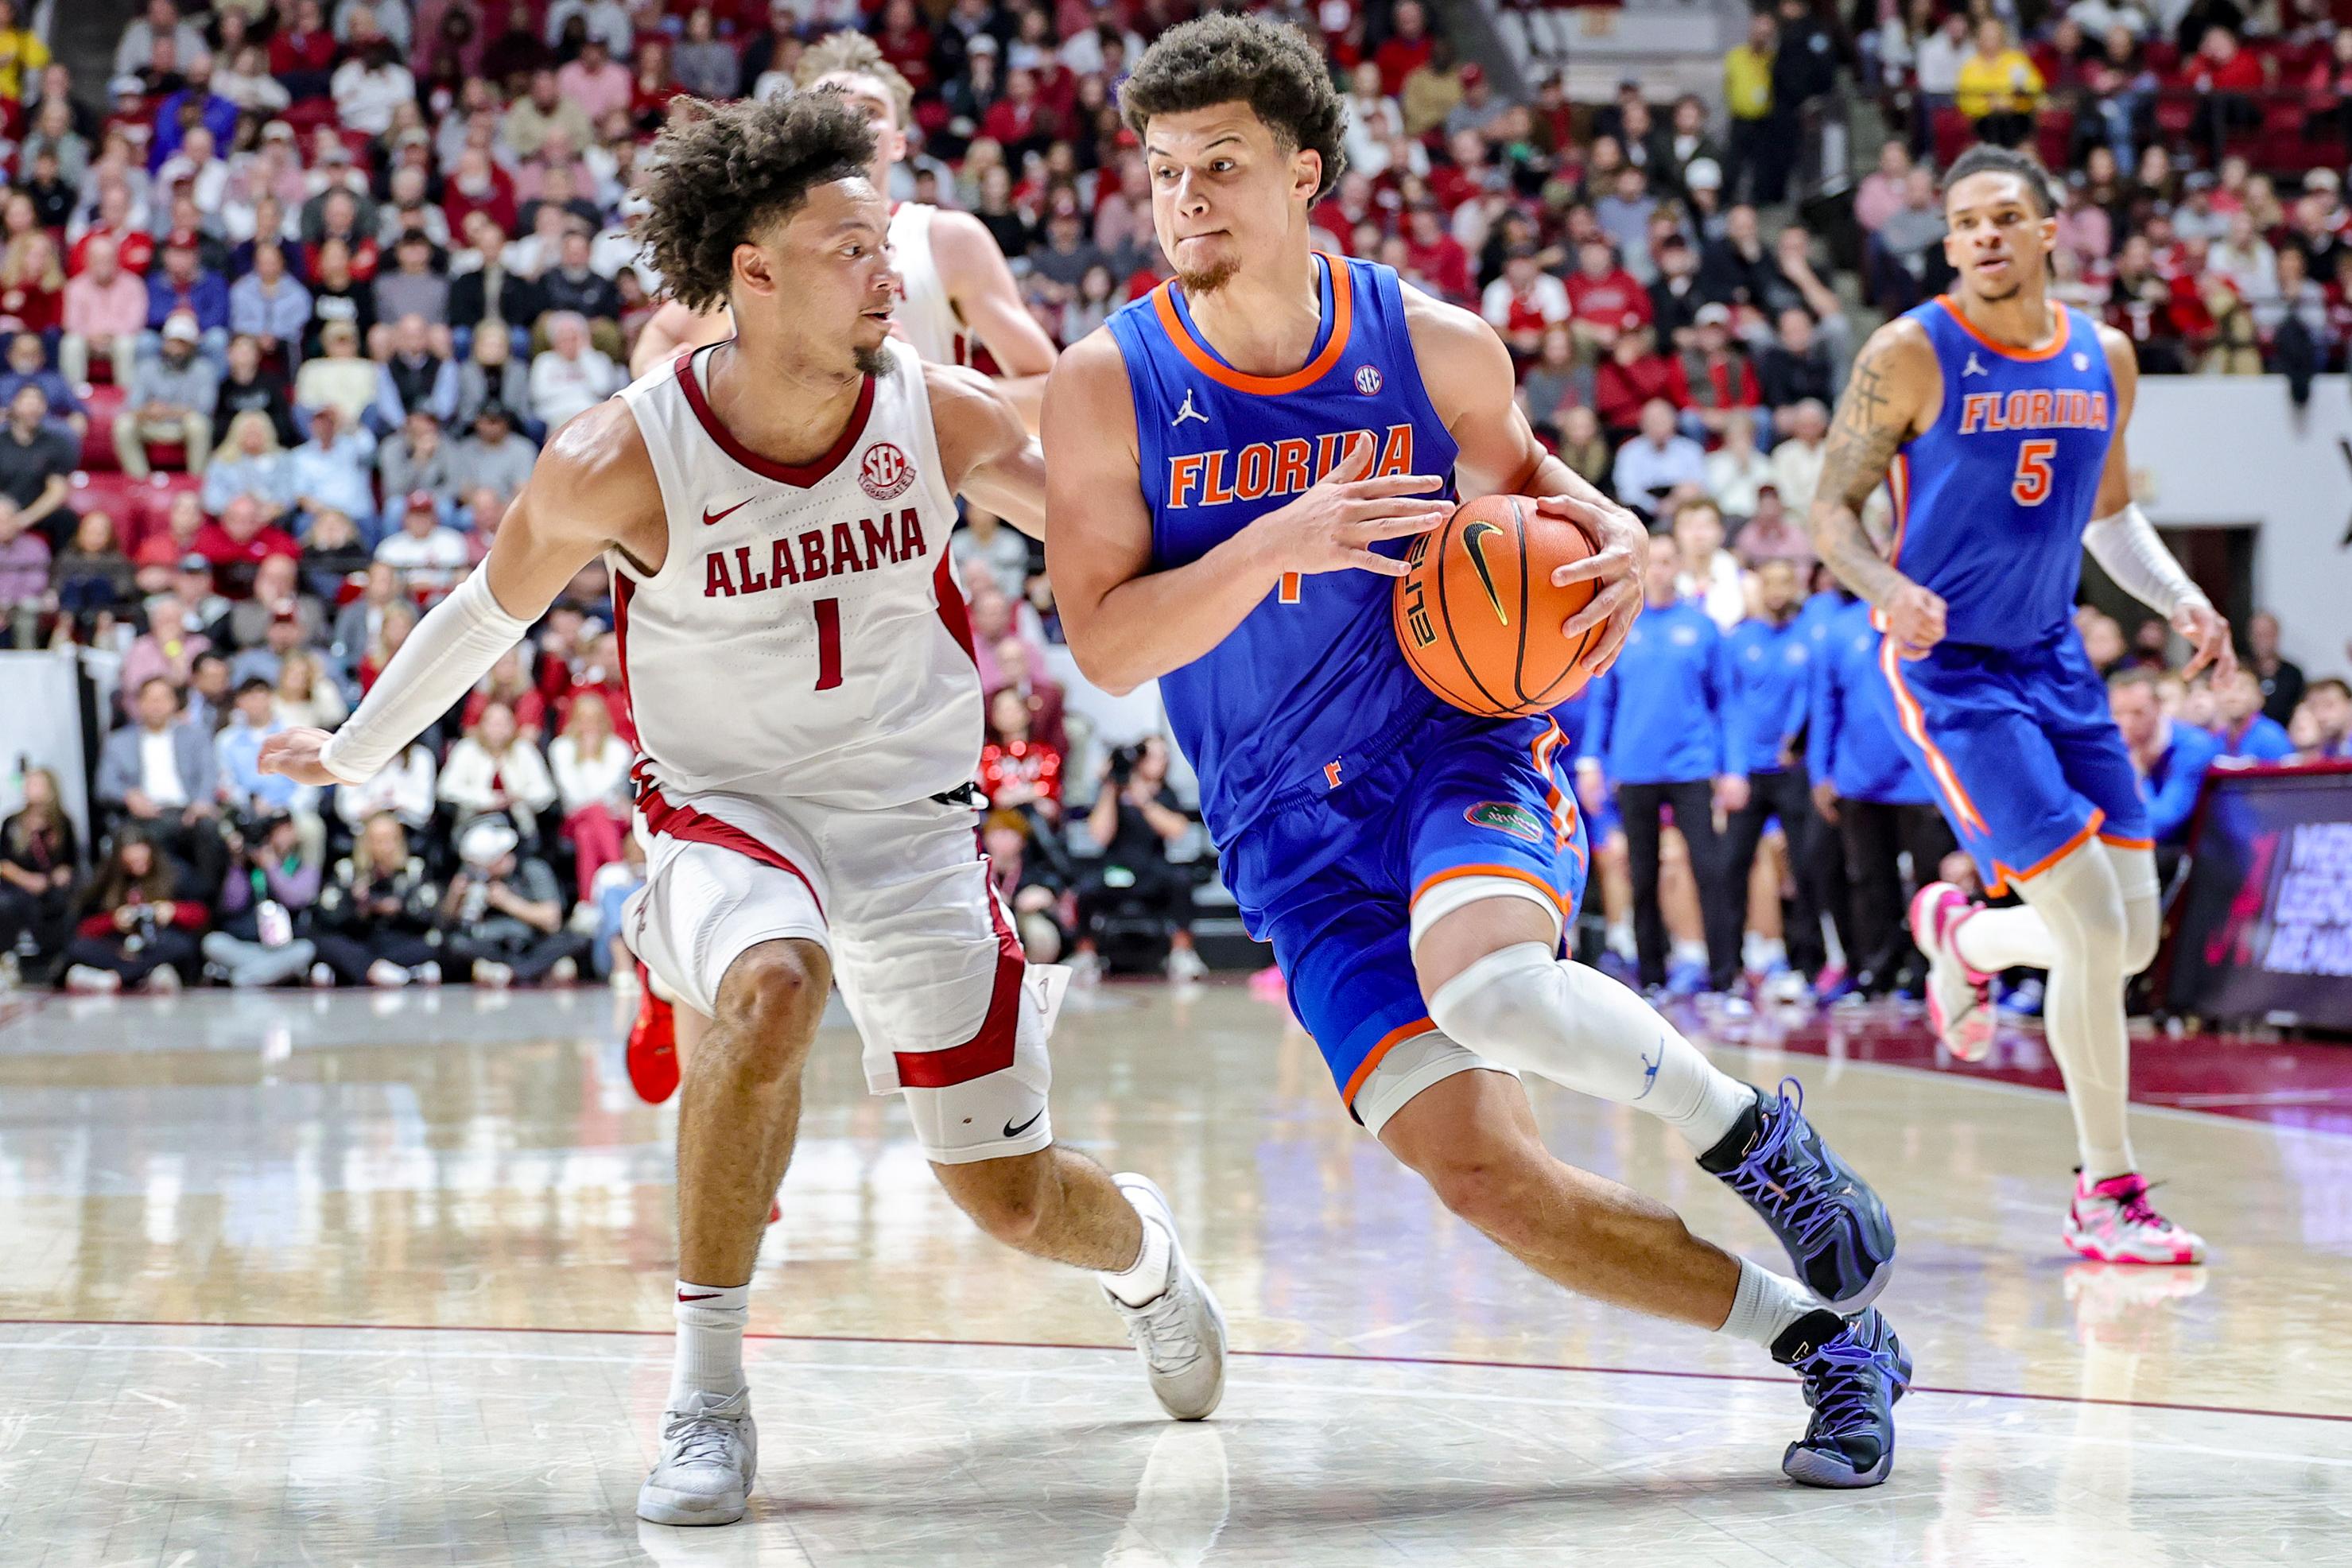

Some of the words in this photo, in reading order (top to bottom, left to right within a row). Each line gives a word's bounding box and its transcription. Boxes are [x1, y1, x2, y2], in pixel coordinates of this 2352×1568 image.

[1356, 367, 1381, 394] SEC
[1958, 388, 2108, 435] FLORIDA
[864, 445, 903, 486] SEC
[1166, 423, 1413, 509] FLORIDA
[2012, 438, 2058, 507] 5
[704, 506, 927, 597] ALABAMA
[1403, 532, 1438, 649] ELITE
[813, 596, 844, 691] 1
